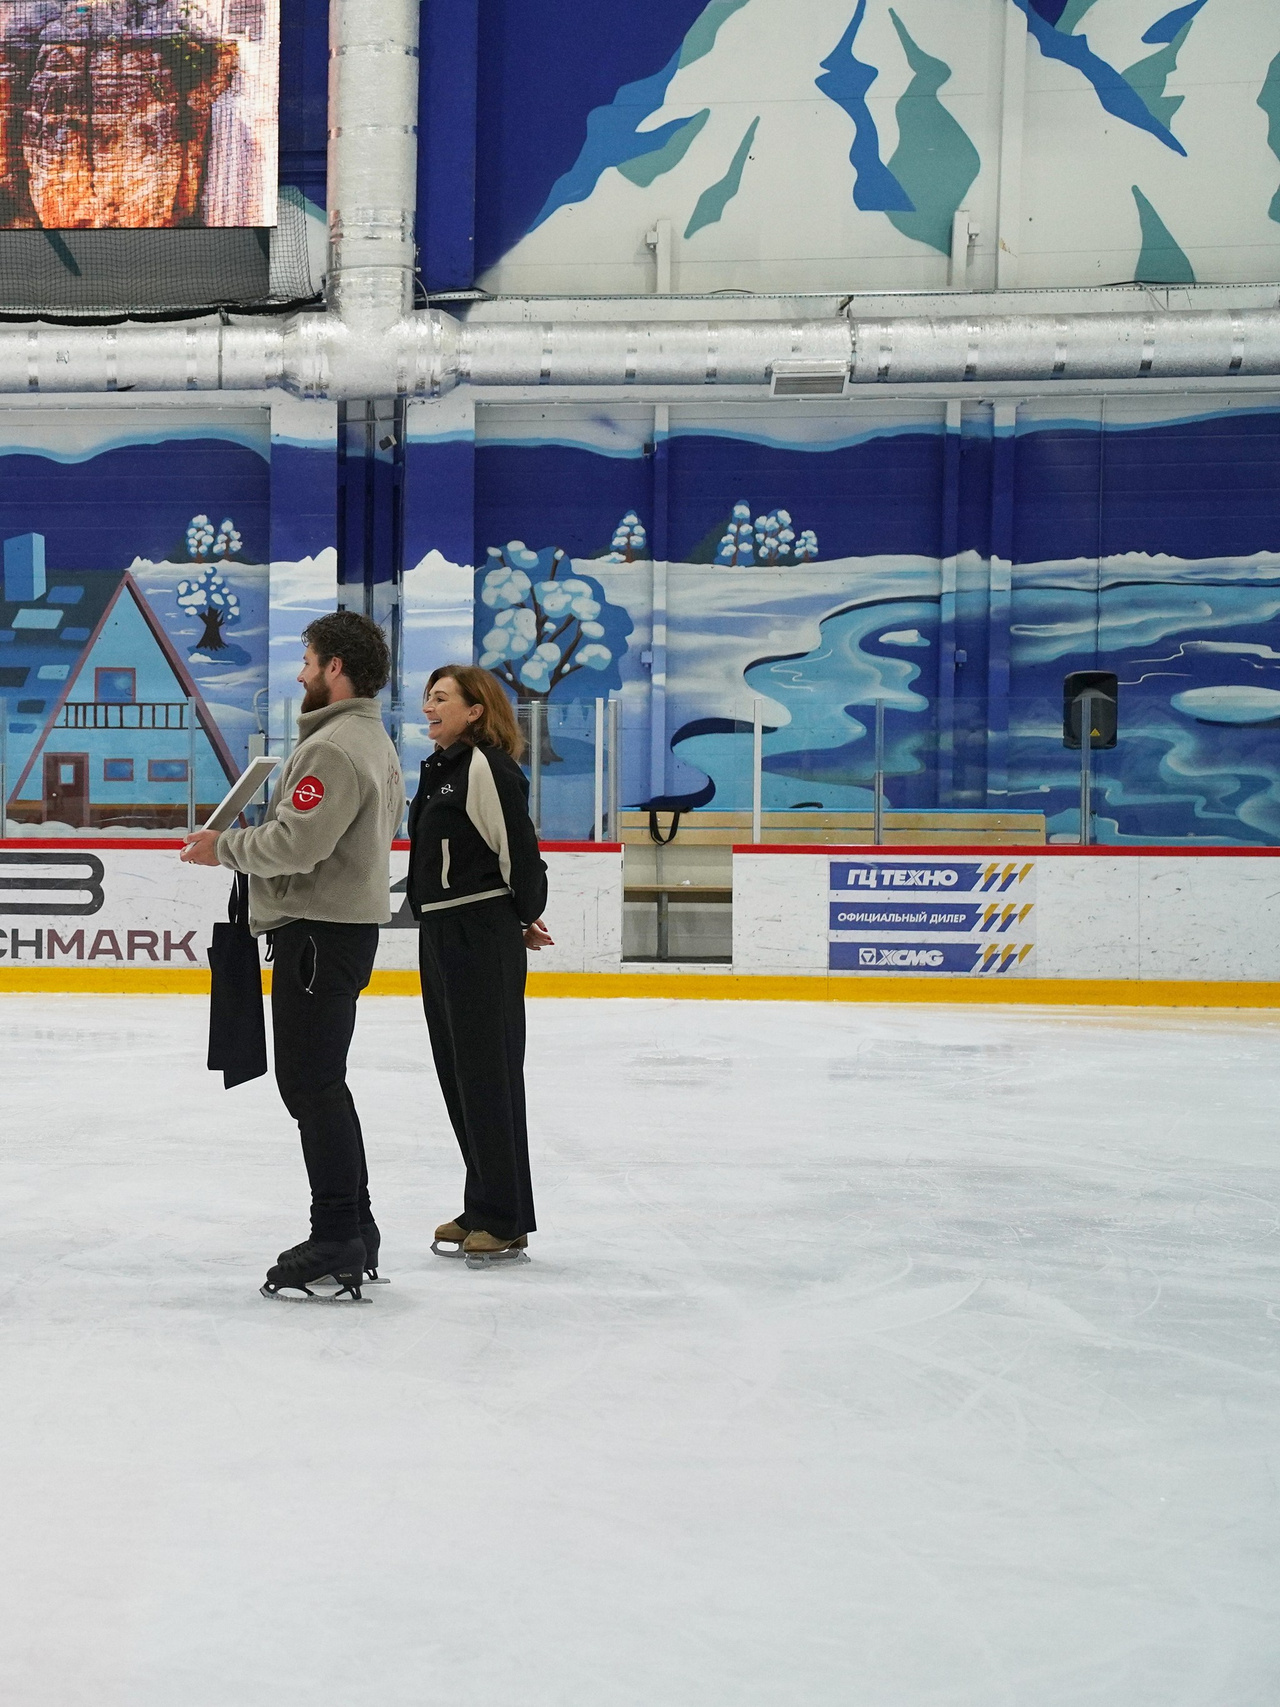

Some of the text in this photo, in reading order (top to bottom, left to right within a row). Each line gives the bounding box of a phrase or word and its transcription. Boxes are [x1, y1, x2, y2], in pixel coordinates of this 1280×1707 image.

[847, 869, 959, 888] ГЦ ТЕХНО
[837, 911, 967, 924] ОФИЦИАЛЬНЫЙ ДИЛЕР
[876, 949, 944, 966] XCMG
